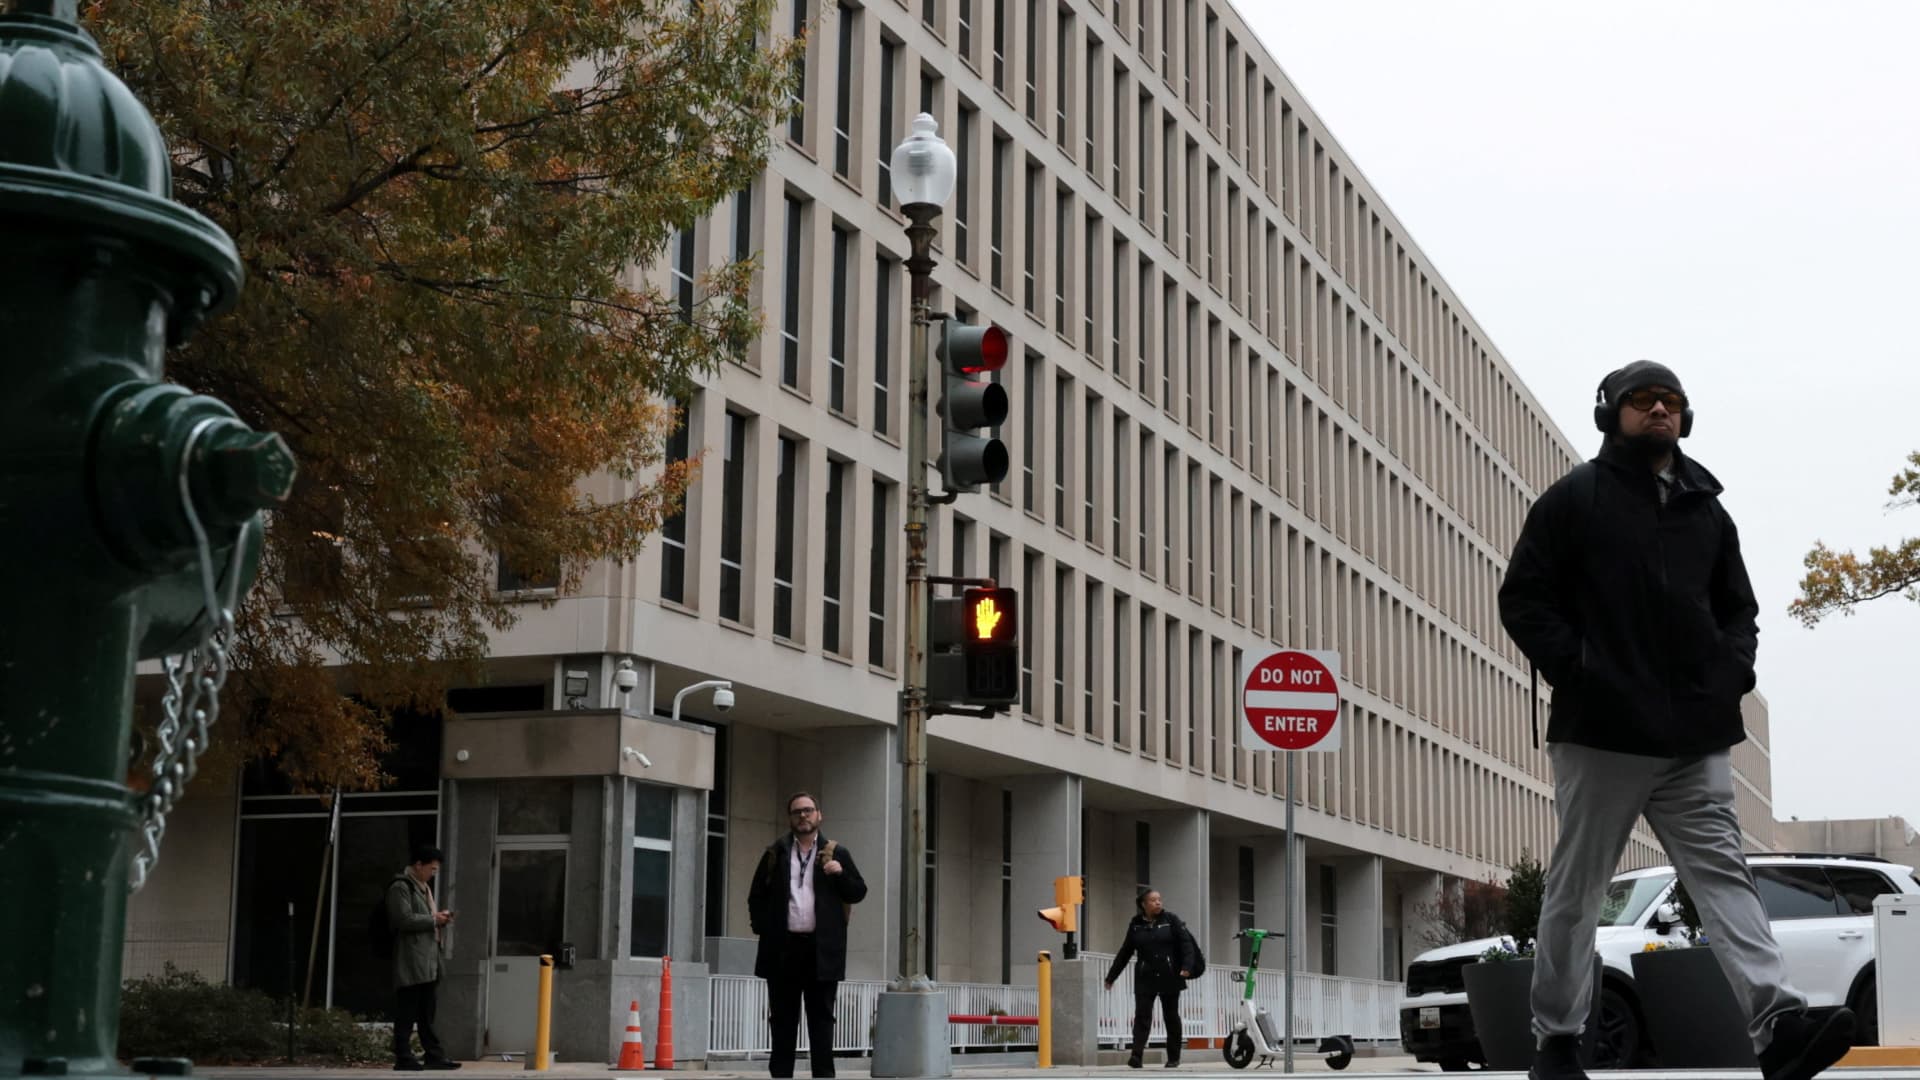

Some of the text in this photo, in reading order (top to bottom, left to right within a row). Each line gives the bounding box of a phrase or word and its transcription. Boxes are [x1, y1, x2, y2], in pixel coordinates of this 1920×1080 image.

[1260, 668, 1322, 685] DO NOT
[1264, 716, 1318, 732] ENTER
